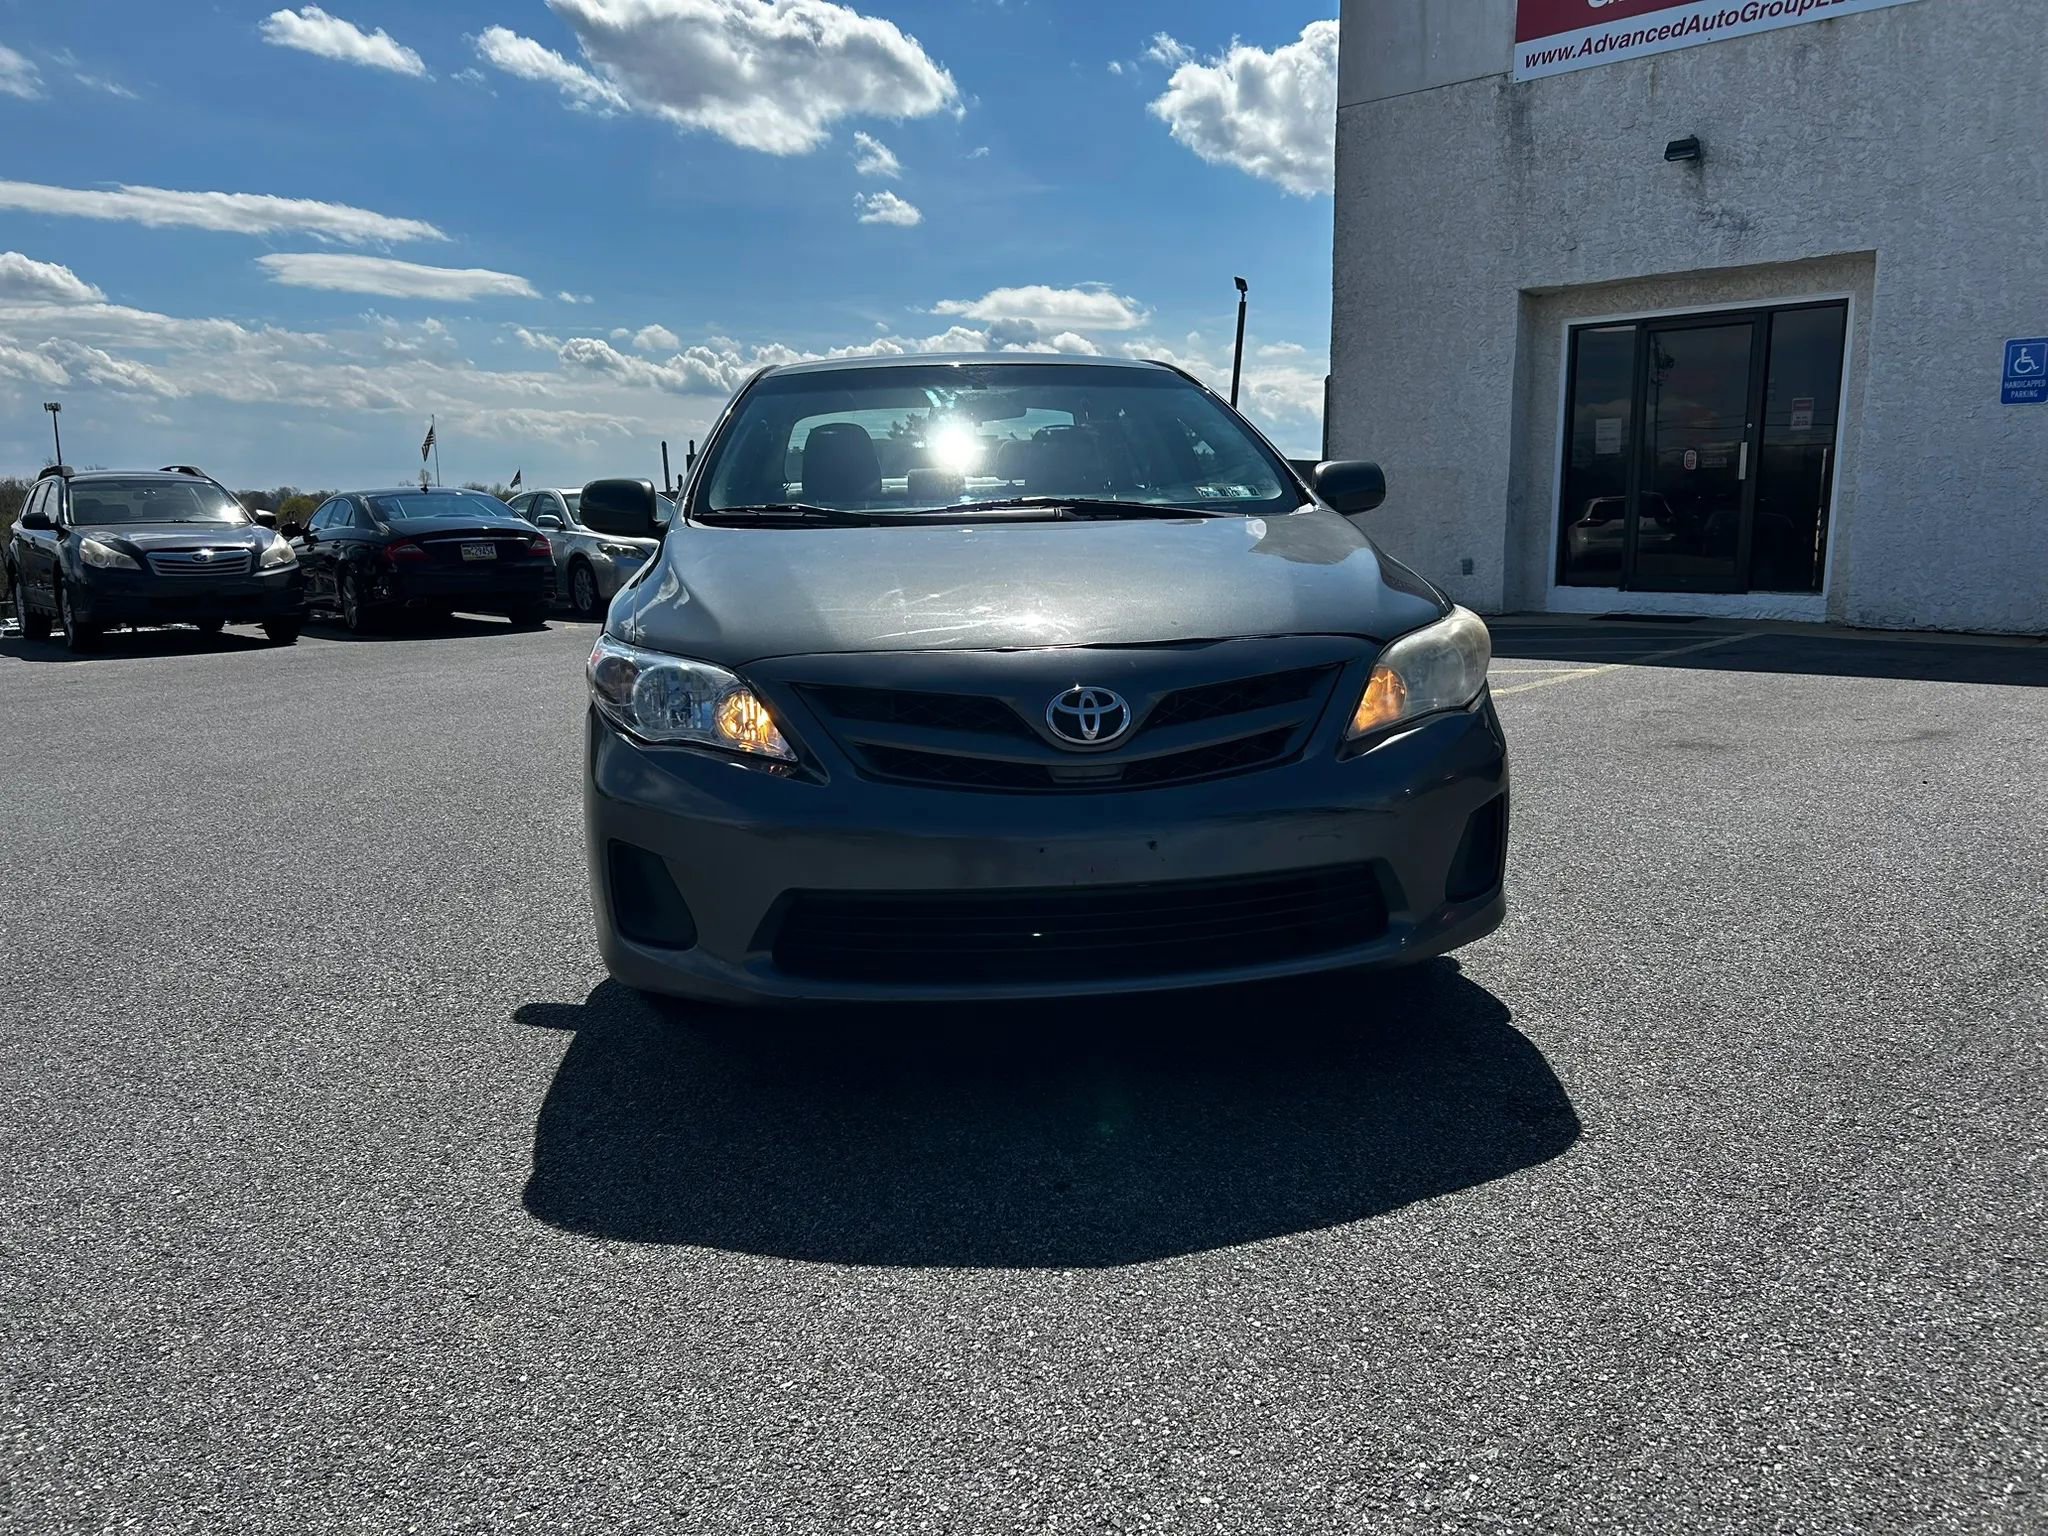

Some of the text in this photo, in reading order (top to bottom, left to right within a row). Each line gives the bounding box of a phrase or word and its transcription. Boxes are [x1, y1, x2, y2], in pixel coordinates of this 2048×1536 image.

[1525, 0, 1845, 68] www.AdvancedAutoGroup
[2004, 379, 2046, 389] HANDICAPPED
[2011, 390, 2038, 398] PARKING
